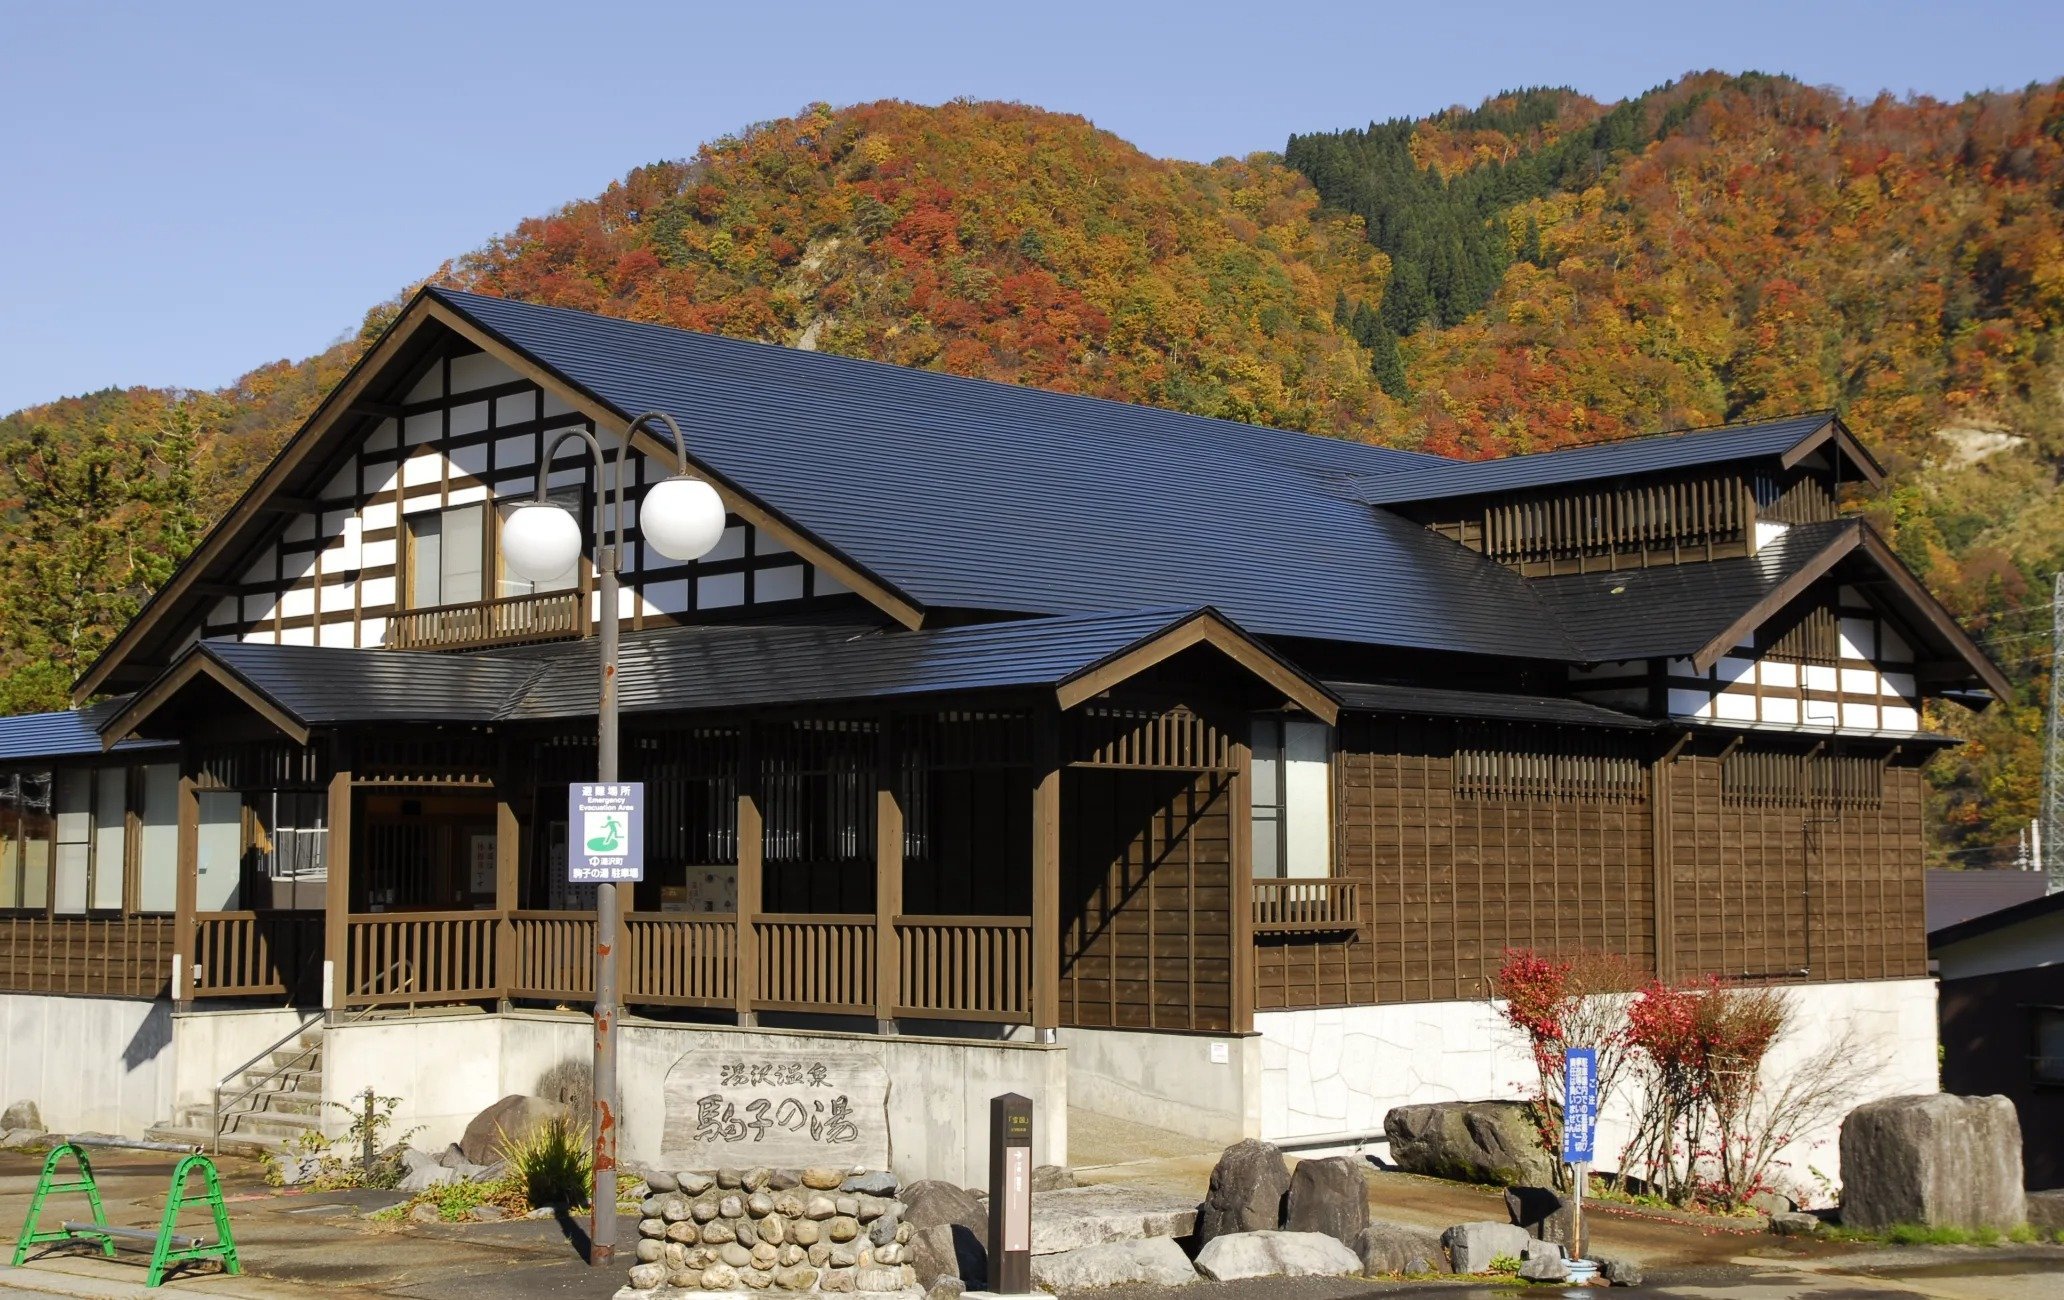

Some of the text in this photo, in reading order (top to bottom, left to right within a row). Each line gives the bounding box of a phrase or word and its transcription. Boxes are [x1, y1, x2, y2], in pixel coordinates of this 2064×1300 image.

[582, 786, 631, 796] 避難場所
[587, 797, 626, 805] Emergency
[573, 867, 639, 878] 駒子の湯 駐車場
[720, 1062, 834, 1088] 湯沢温泉
[693, 1093, 859, 1144] 駒子の湯
